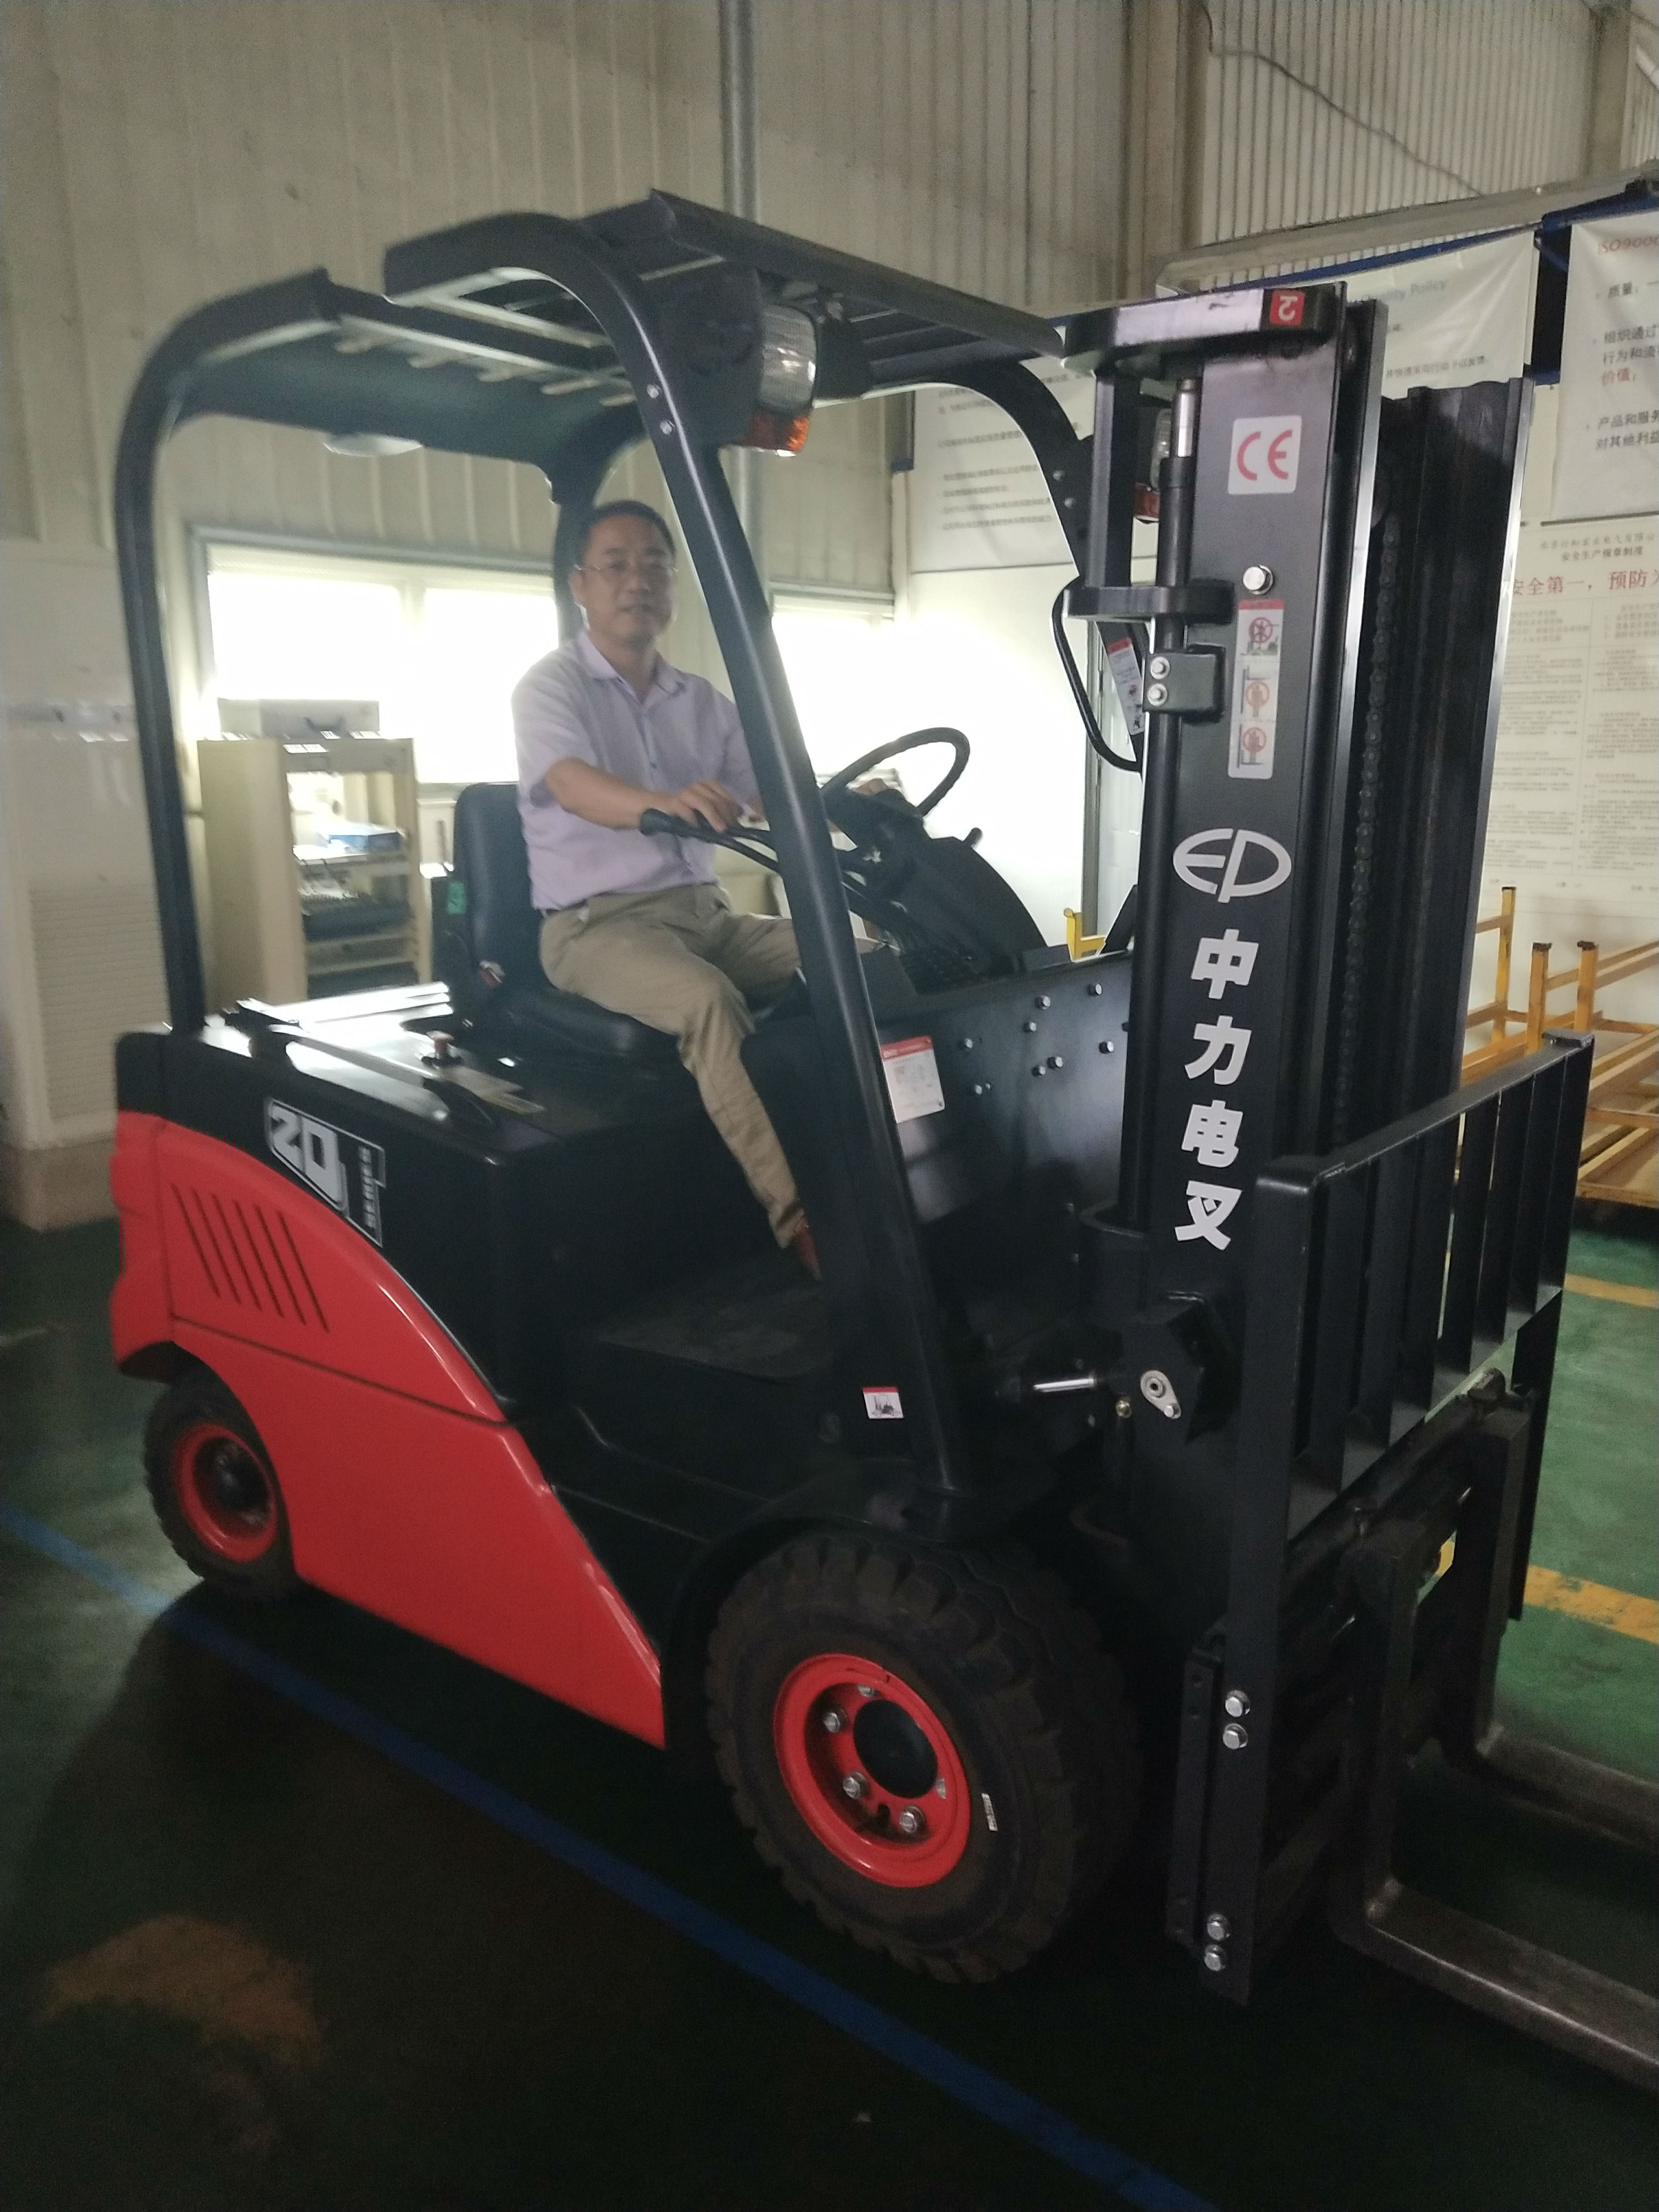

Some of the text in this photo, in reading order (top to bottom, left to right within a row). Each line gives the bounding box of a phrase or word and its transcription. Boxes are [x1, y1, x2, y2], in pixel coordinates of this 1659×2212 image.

[1237, 430, 1293, 482] CE
[1175, 928, 1260, 1251] 中力电叉
